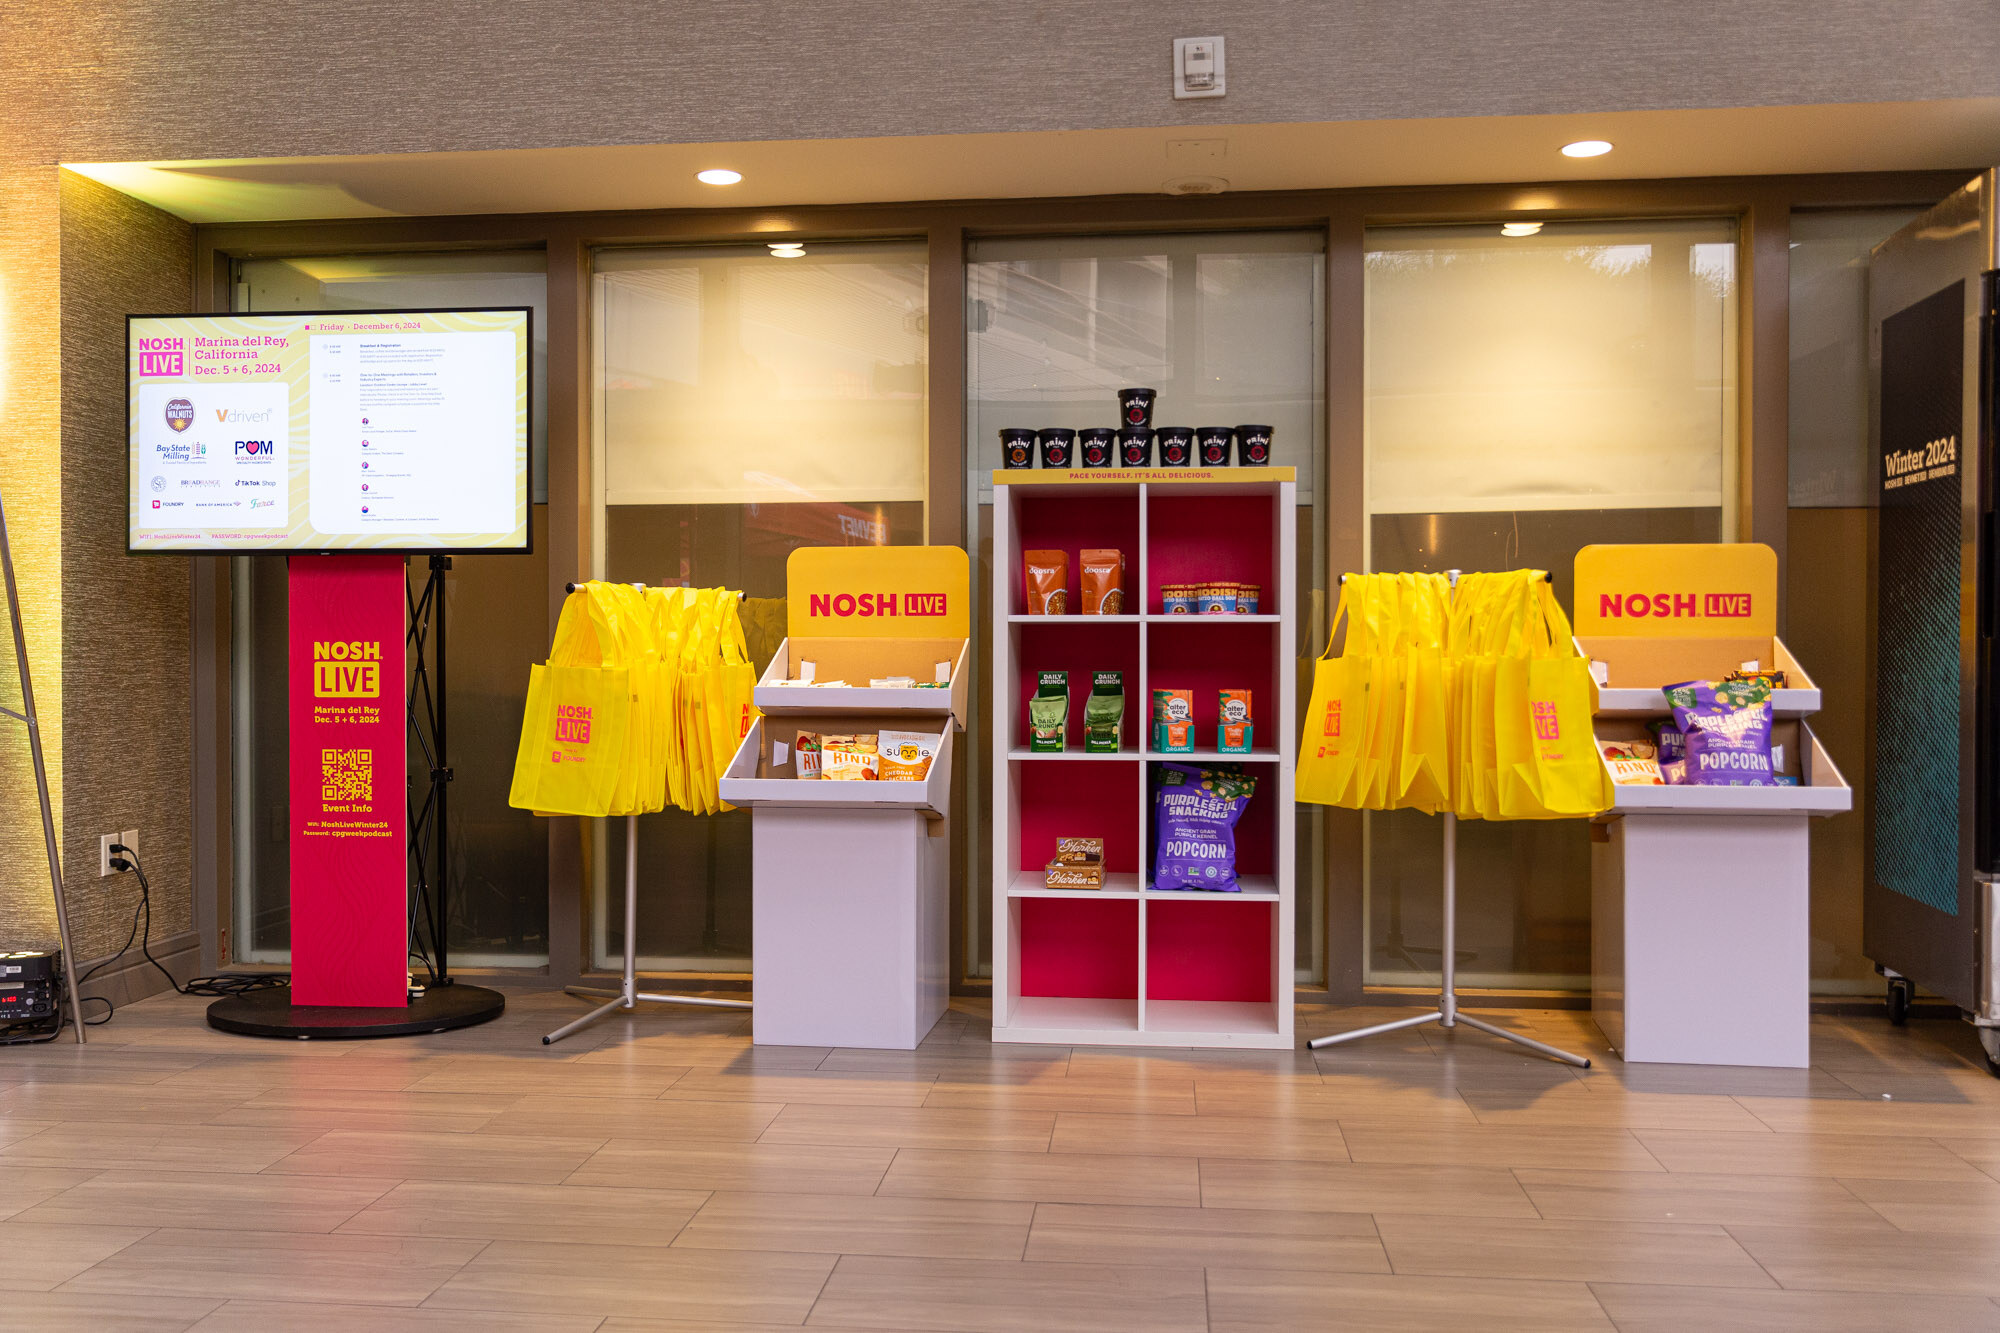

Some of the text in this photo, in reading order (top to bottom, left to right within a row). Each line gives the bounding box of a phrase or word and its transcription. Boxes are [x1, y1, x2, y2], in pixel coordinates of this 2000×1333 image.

[320, 323, 345, 332] Friday
[395, 322, 402, 330] 6,
[139, 338, 183, 350] NOSH
[195, 336, 289, 348] Marina del Rey,
[195, 349, 258, 360] California
[142, 354, 181, 374] LIVE
[195, 365, 220, 375] Dec.
[223, 365, 230, 375] 5
[242, 365, 252, 375] 6,
[255, 364, 281, 374] 2024
[167, 410, 192, 419] WALNUTS
[157, 445, 171, 453] Bay
[163, 452, 190, 462] Milling
[1885, 449, 1925, 477] Winter
[1926, 435, 1955, 467] 2024
[1084, 566, 1111, 574] doosra
[810, 593, 945, 617] NOSH LIVE
[1600, 593, 1749, 617] NOSH LIVE
[313, 641, 380, 660] NOSH
[319, 665, 375, 693] LIVE
[314, 706, 380, 716] Marina del Rey
[557, 704, 593, 719] NOSH
[349, 716, 357, 724] 6,
[557, 719, 589, 742] LIVE
[886, 747, 929, 757] sunnie
[833, 752, 871, 766] RIND
[1700, 751, 1769, 771] POPCORN
[1614, 762, 1656, 775] RIND
[322, 804, 373, 813] Event Info
[1164, 794, 1238, 812] PURPLESFUL
[1168, 805, 1228, 819] SNACKING
[331, 830, 393, 838] cpgweekpodcast
[1058, 838, 1101, 853] Harken
[1166, 840, 1227, 859] POPCORN
[1046, 870, 1088, 884] Harken
